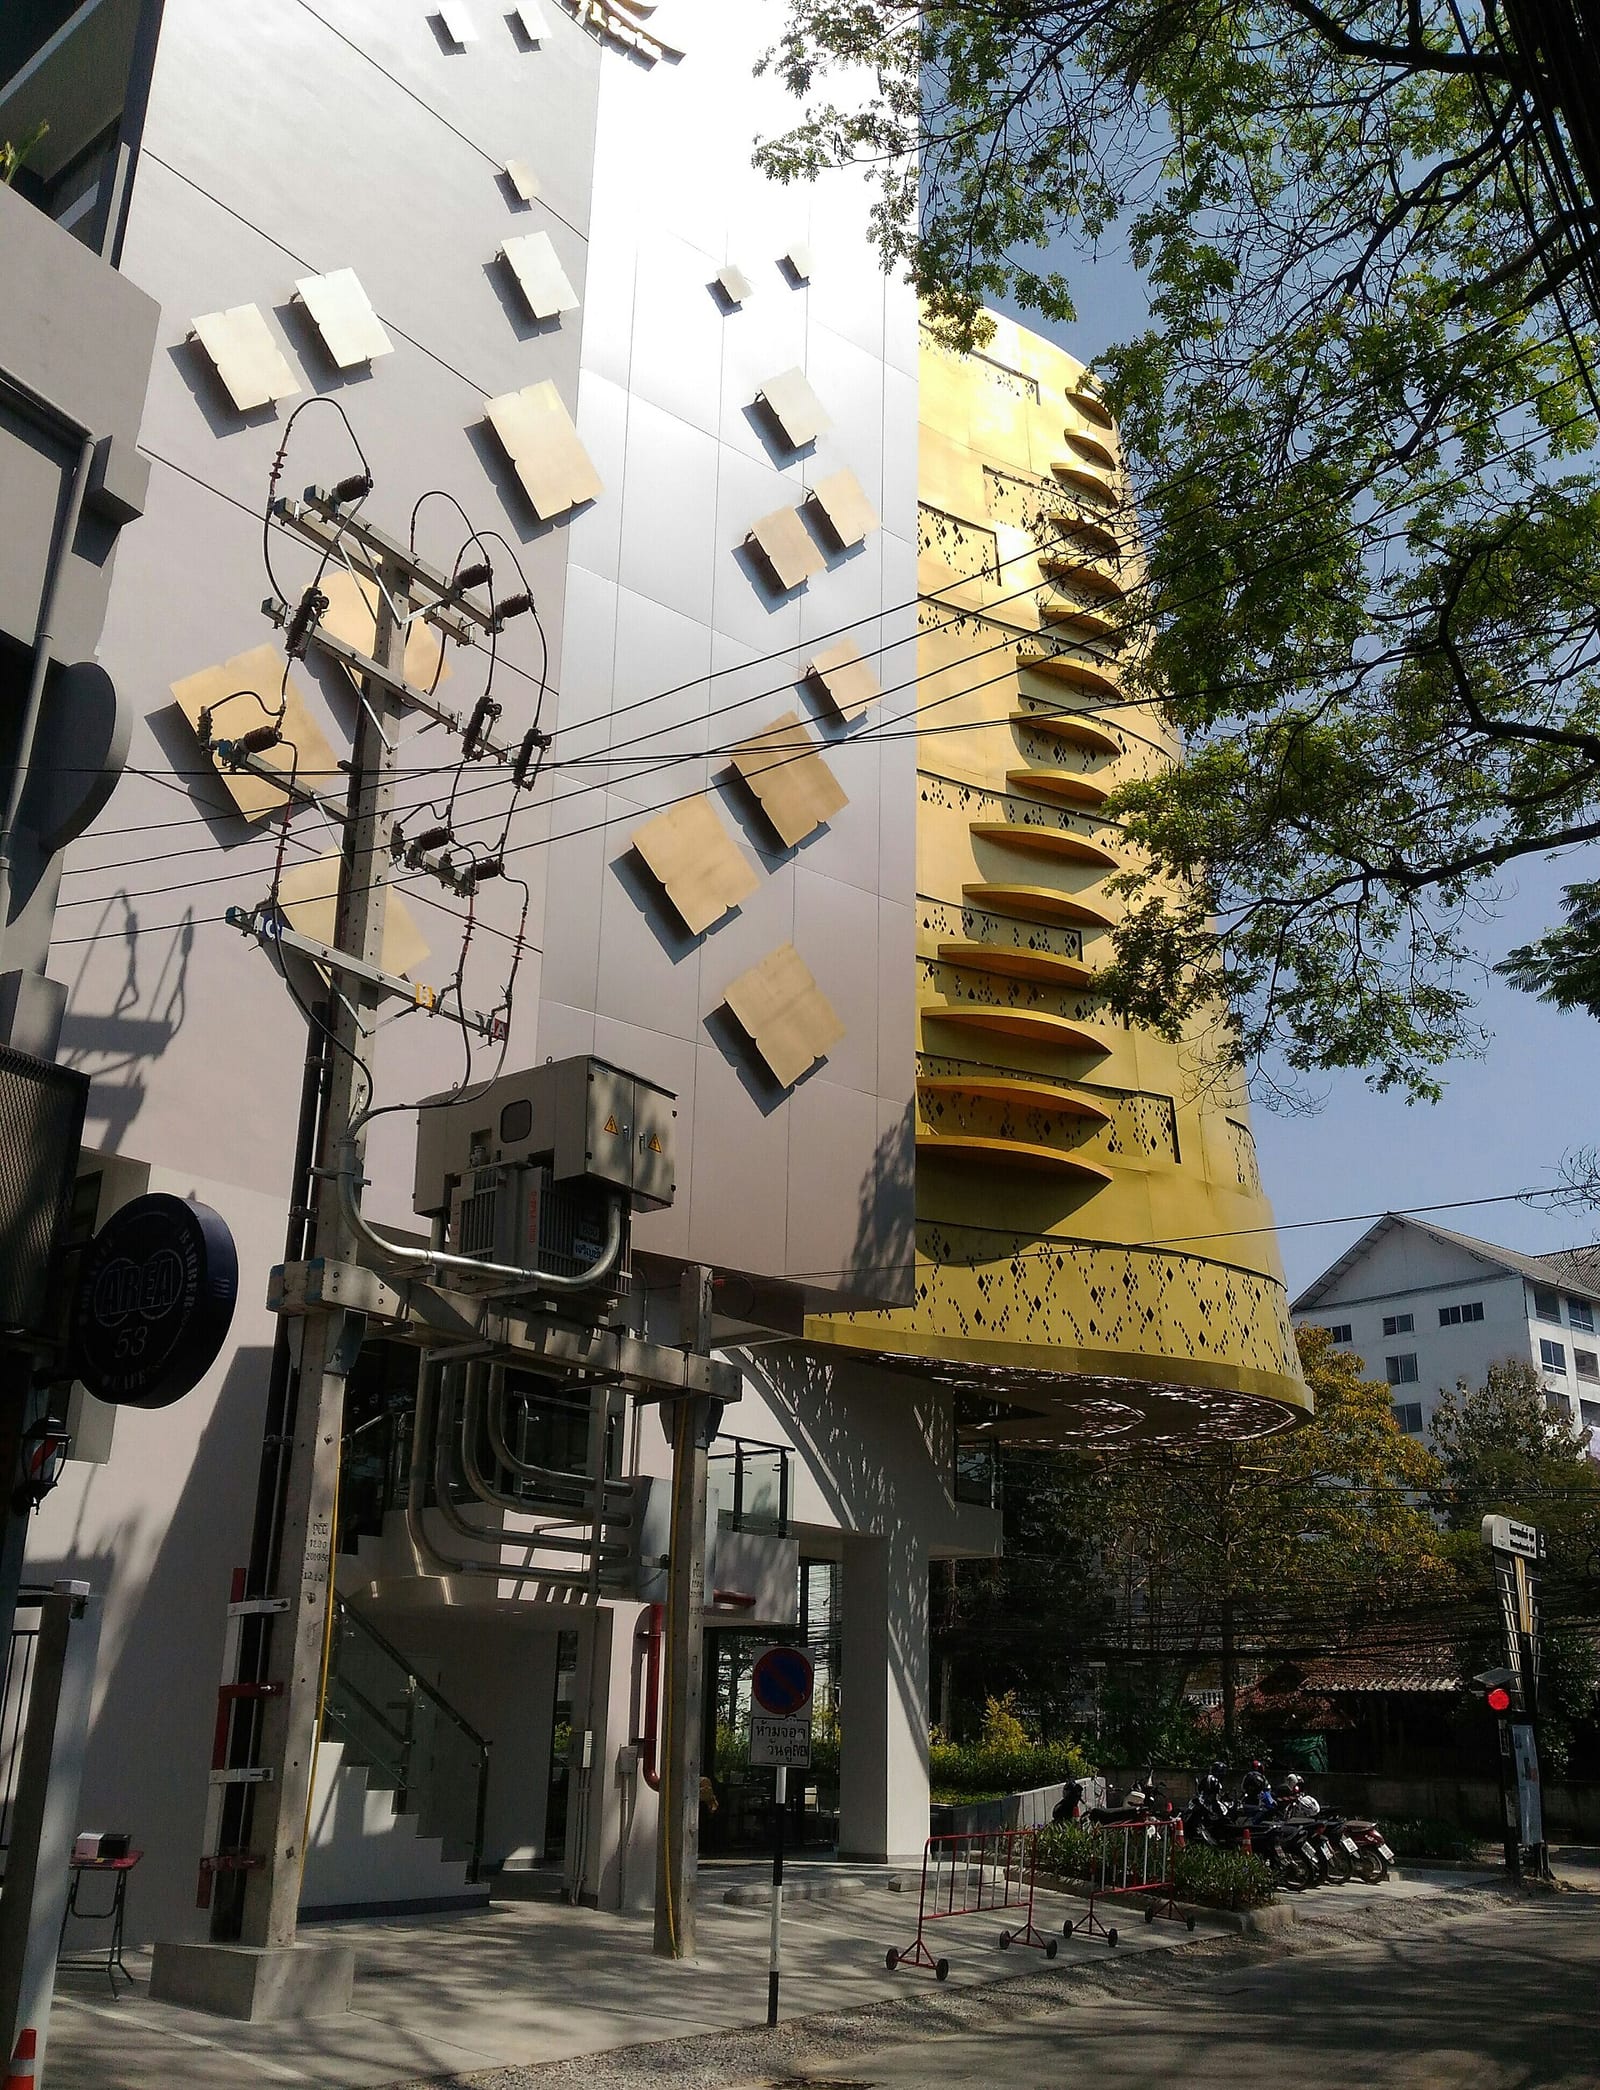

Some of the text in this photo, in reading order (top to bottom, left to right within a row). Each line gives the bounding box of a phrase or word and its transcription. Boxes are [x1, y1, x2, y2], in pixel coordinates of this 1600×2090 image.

[98, 1257, 174, 1317] AREA
[178, 1230, 199, 1308] BARBER
[114, 1325, 148, 1359] 53
